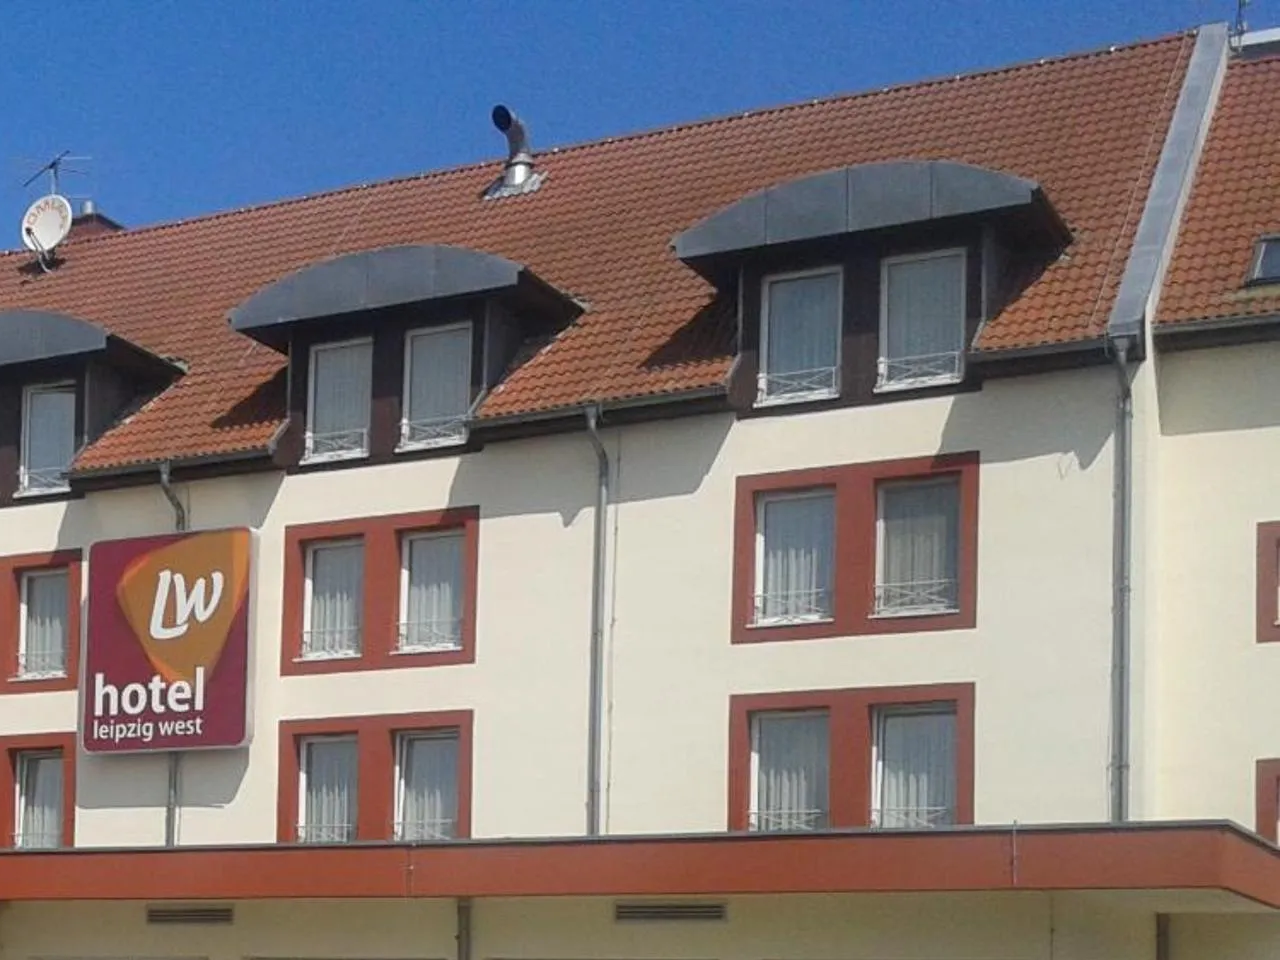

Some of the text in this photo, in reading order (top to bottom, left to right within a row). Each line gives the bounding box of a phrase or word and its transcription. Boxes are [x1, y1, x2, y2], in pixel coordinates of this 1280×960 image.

[150, 569, 224, 640] LW
[94, 666, 204, 717] hotel
[93, 717, 203, 743] leipzig west
